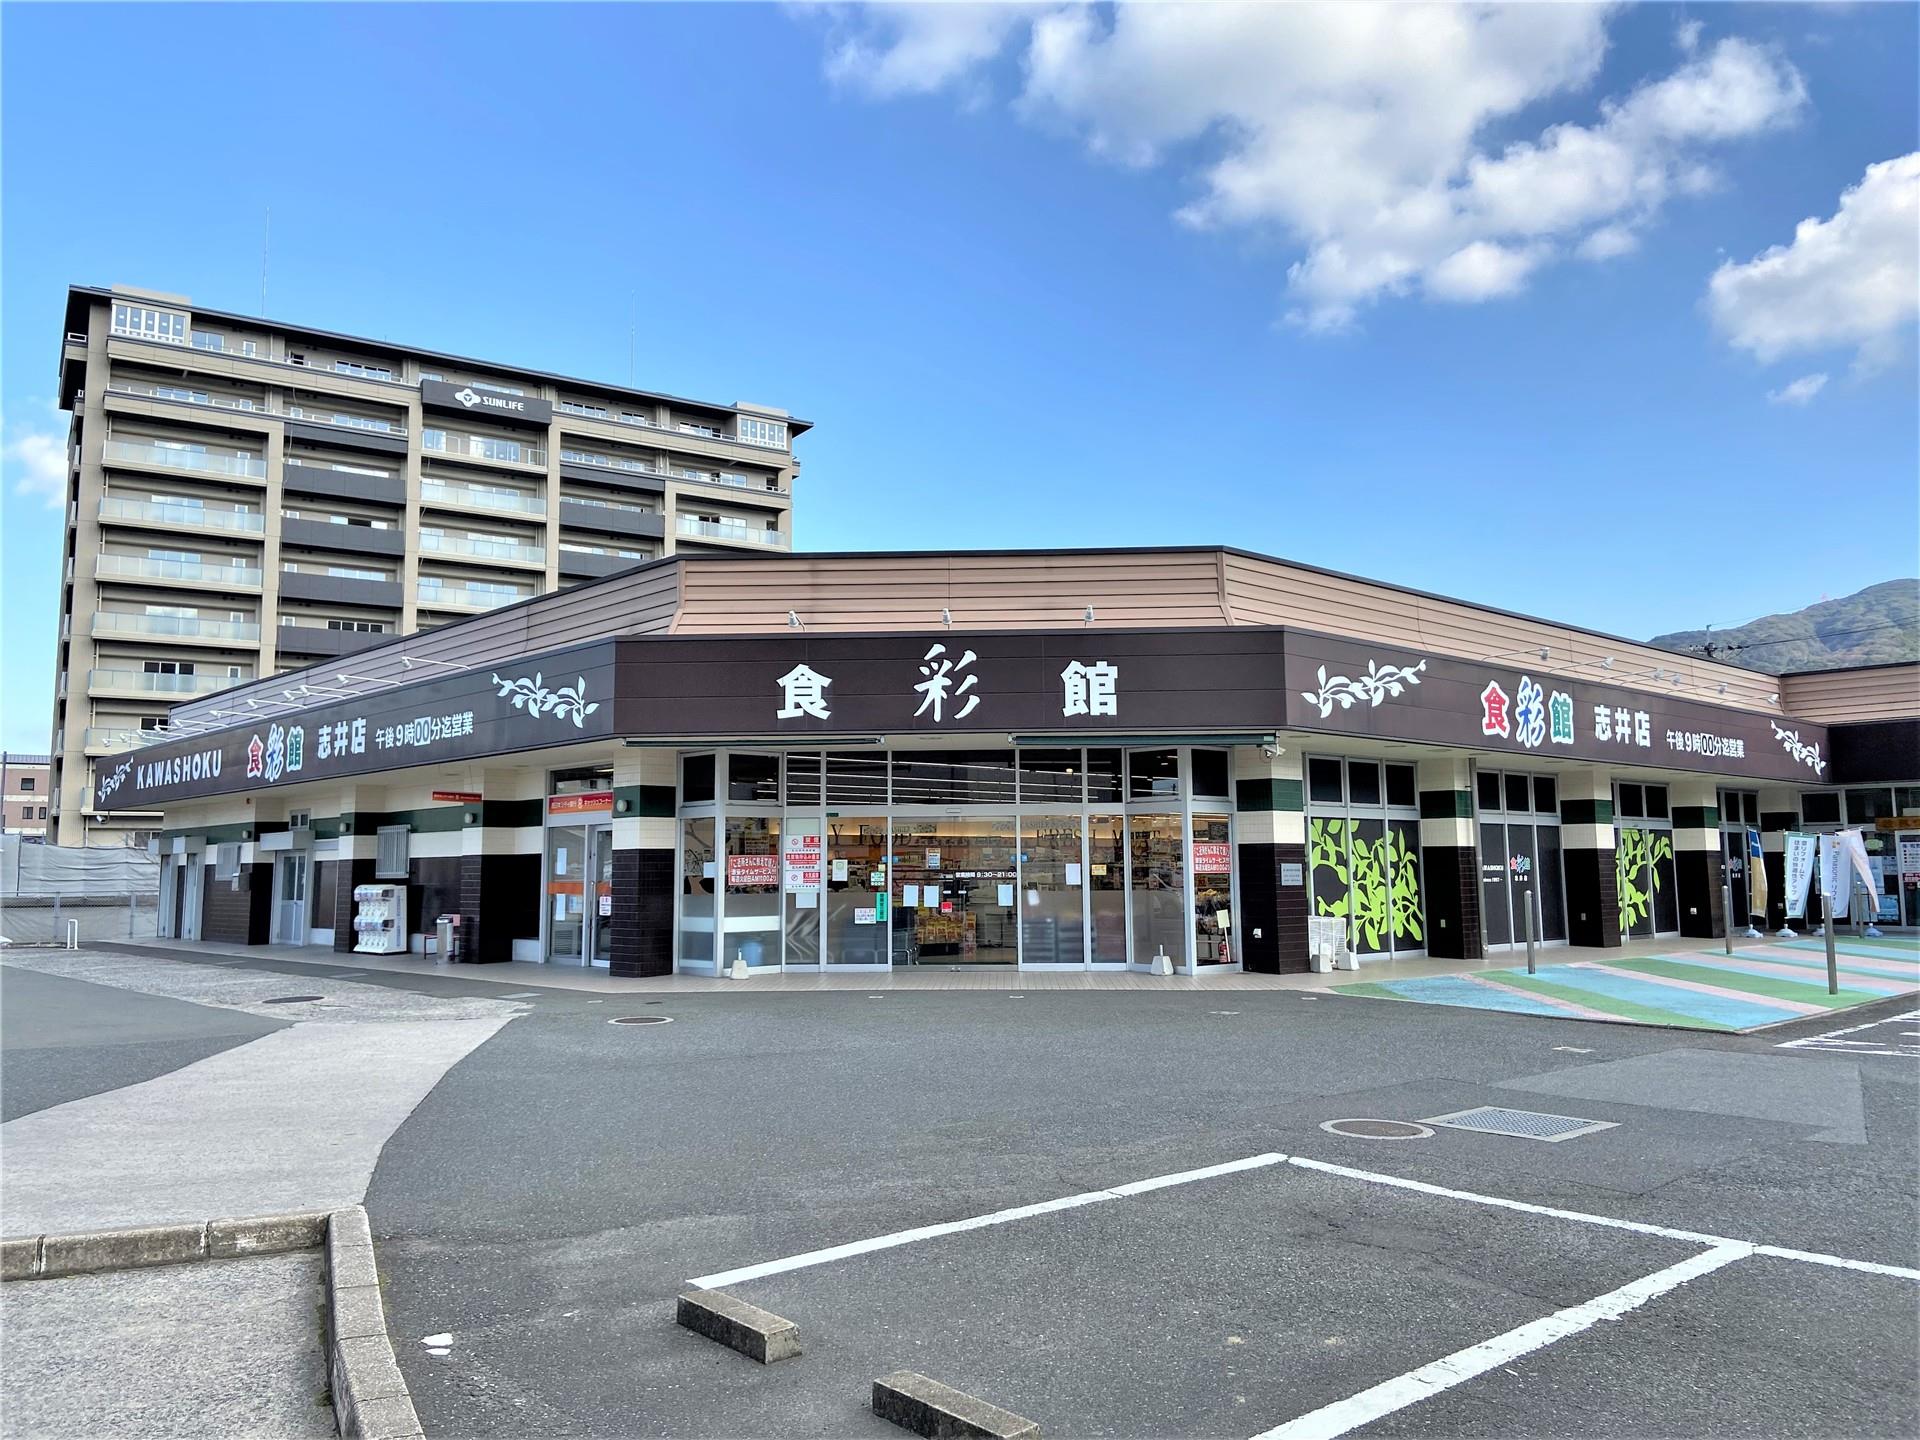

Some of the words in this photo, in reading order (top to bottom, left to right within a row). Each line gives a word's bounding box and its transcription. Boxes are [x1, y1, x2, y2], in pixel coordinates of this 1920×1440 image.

[482, 396, 524, 411] SUNLIFE
[776, 644, 1118, 722] 食彩館
[1481, 676, 1574, 749] 食彩館
[1594, 705, 1651, 748] 志井店
[136, 749, 222, 789] KAWASHOKU
[247, 723, 304, 782] 食彩館
[316, 717, 367, 759] 志井店
